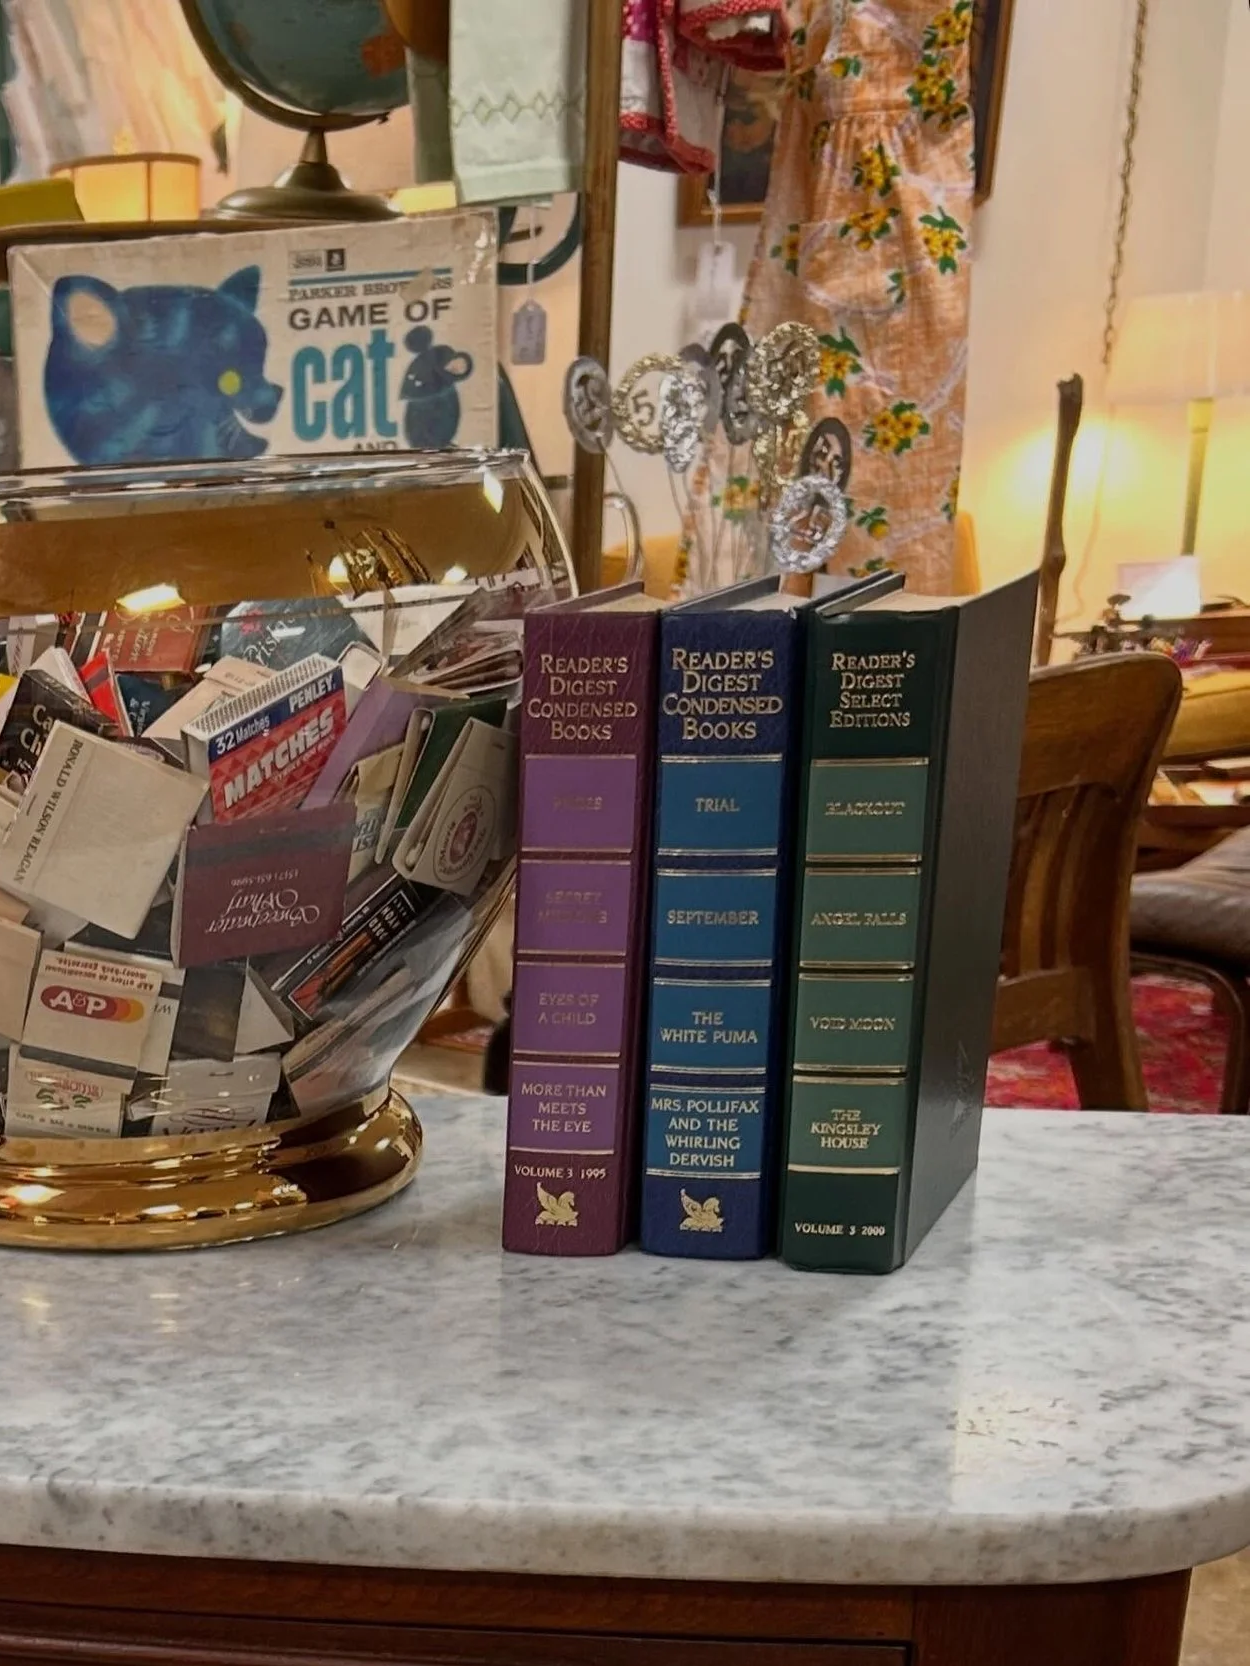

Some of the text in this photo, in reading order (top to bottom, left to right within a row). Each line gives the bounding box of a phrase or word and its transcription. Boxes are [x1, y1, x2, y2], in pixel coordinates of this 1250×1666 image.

[288, 285, 357, 301] PARKER
[289, 297, 452, 331] GAME OF
[291, 329, 397, 442] cat
[540, 654, 629, 674] READER'S
[672, 647, 774, 671] READER'S
[831, 651, 916, 673] READER'S
[550, 676, 618, 696] DIGEST
[681, 673, 763, 693] DIGEST
[840, 672, 905, 691] DIGEST
[527, 698, 637, 719] CONDENSED
[662, 695, 783, 717] CONDENSED
[839, 692, 903, 710] SELECT
[829, 710, 911, 729] EDITIONS
[215, 713, 271, 755] 32 Matches
[550, 722, 613, 741] BOOKS
[682, 720, 757, 740] BOOKS
[57, 738, 85, 788] RONALD
[223, 706, 335, 809] MATCHES
[695, 798, 740, 813] TRIAL
[825, 802, 905, 816] BLACKOUT
[35, 791, 62, 838] WILSON
[13, 836, 43, 883] REAGAN
[221, 889, 299, 917] Wharf
[667, 909, 759, 926] SEPTEMBER
[811, 911, 907, 926] ANGEL FALLS
[49, 989, 107, 1016] A&P
[539, 992, 599, 1007] EYES OF
[538, 1012, 596, 1026] A CHILD
[692, 1011, 724, 1026] THE
[810, 1016, 895, 1031] VOID MOON
[660, 1028, 758, 1044] WHITE PUMA
[522, 1083, 606, 1098] MORE THAN
[538, 1103, 587, 1115] MEETS
[651, 1098, 760, 1114] MRS. POLLIFAX
[831, 1109, 861, 1121] THE
[532, 1119, 592, 1133] THE EYE
[668, 1117, 739, 1131] AND THE
[810, 1122, 882, 1136] KINGSLEY
[665, 1135, 740, 1150] WHIRLING
[821, 1136, 869, 1149] HOUSE
[669, 1153, 735, 1167] DERVISH
[514, 1165, 606, 1180] VOLUME 3 1995
[794, 1222, 844, 1235] VOLUME
[861, 1225, 886, 1236] 2000
